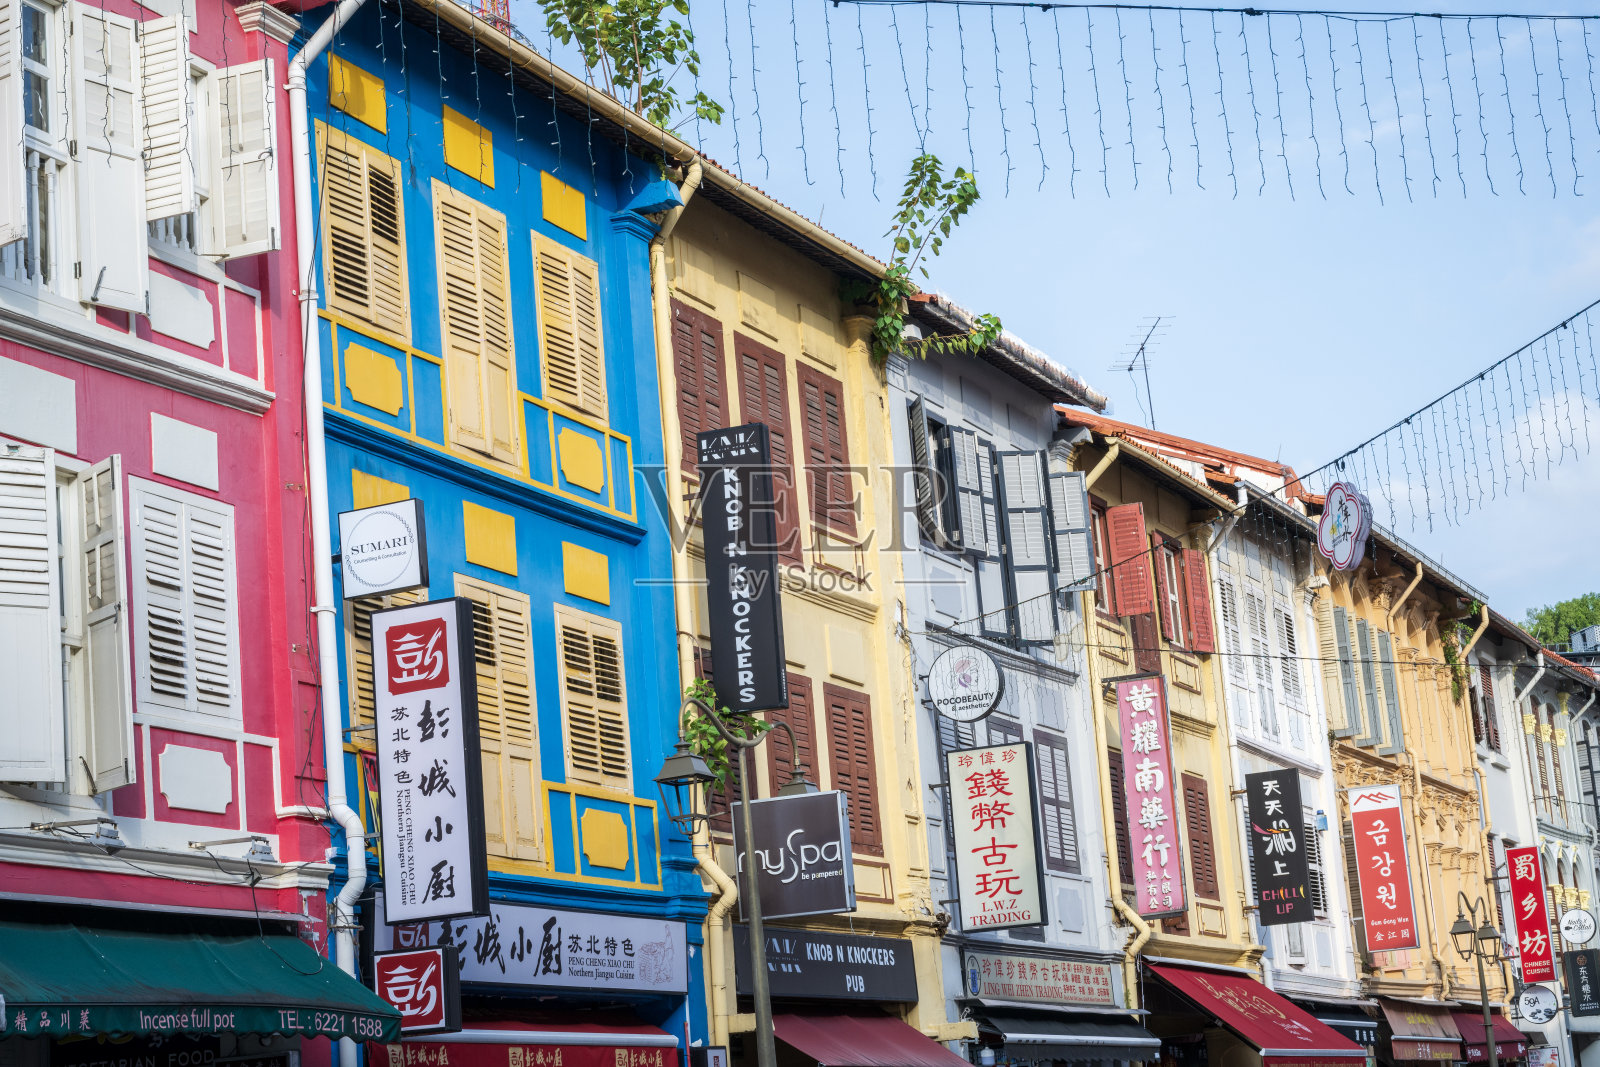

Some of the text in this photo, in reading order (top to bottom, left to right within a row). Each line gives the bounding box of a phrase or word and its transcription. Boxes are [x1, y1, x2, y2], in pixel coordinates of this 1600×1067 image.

[351, 536, 408, 556] SUMARI
[937, 692, 994, 706] POCOBEAUTY
[958, 702, 990, 711] aesthetics
[391, 706, 414, 785] 苏北特色
[958, 749, 1017, 768] 玲偉珍
[404, 788, 412, 815] PENG
[405, 817, 413, 853] CHENG
[965, 768, 1023, 898] 錢幣古玩
[396, 790, 409, 906] Northern Jiangsu Cuisine
[407, 855, 415, 881] XIAO
[1366, 819, 1397, 910] 금강원
[801, 869, 843, 880] be pampered
[981, 899, 1018, 912] L.W.Z
[1276, 903, 1294, 915] UP
[1512, 854, 1548, 958] 蜀乡坊
[970, 910, 1031, 926] TRADING
[568, 934, 635, 957] 苏北特色
[805, 942, 895, 966] KNOB N KNOCKERS
[569, 957, 635, 969] PENG CHENG XIAO CHU
[1524, 960, 1551, 968] CHINESE
[1526, 967, 1551, 975] CUISINE
[569, 967, 634, 981] Northern Jiangsu Cuisine
[846, 974, 865, 993] PUB
[983, 982, 1000, 995] LING
[1001, 983, 1016, 996] WEI
[1016, 984, 1034, 997] ZHEN
[1035, 985, 1063, 998] TRADING
[15, 1008, 92, 1032] 精品川菜
[139, 1008, 235, 1032] Incense full pot
[314, 1012, 345, 1033] 6221
[351, 1016, 383, 1037] 1588
[168, 1049, 214, 1067] FOOD
